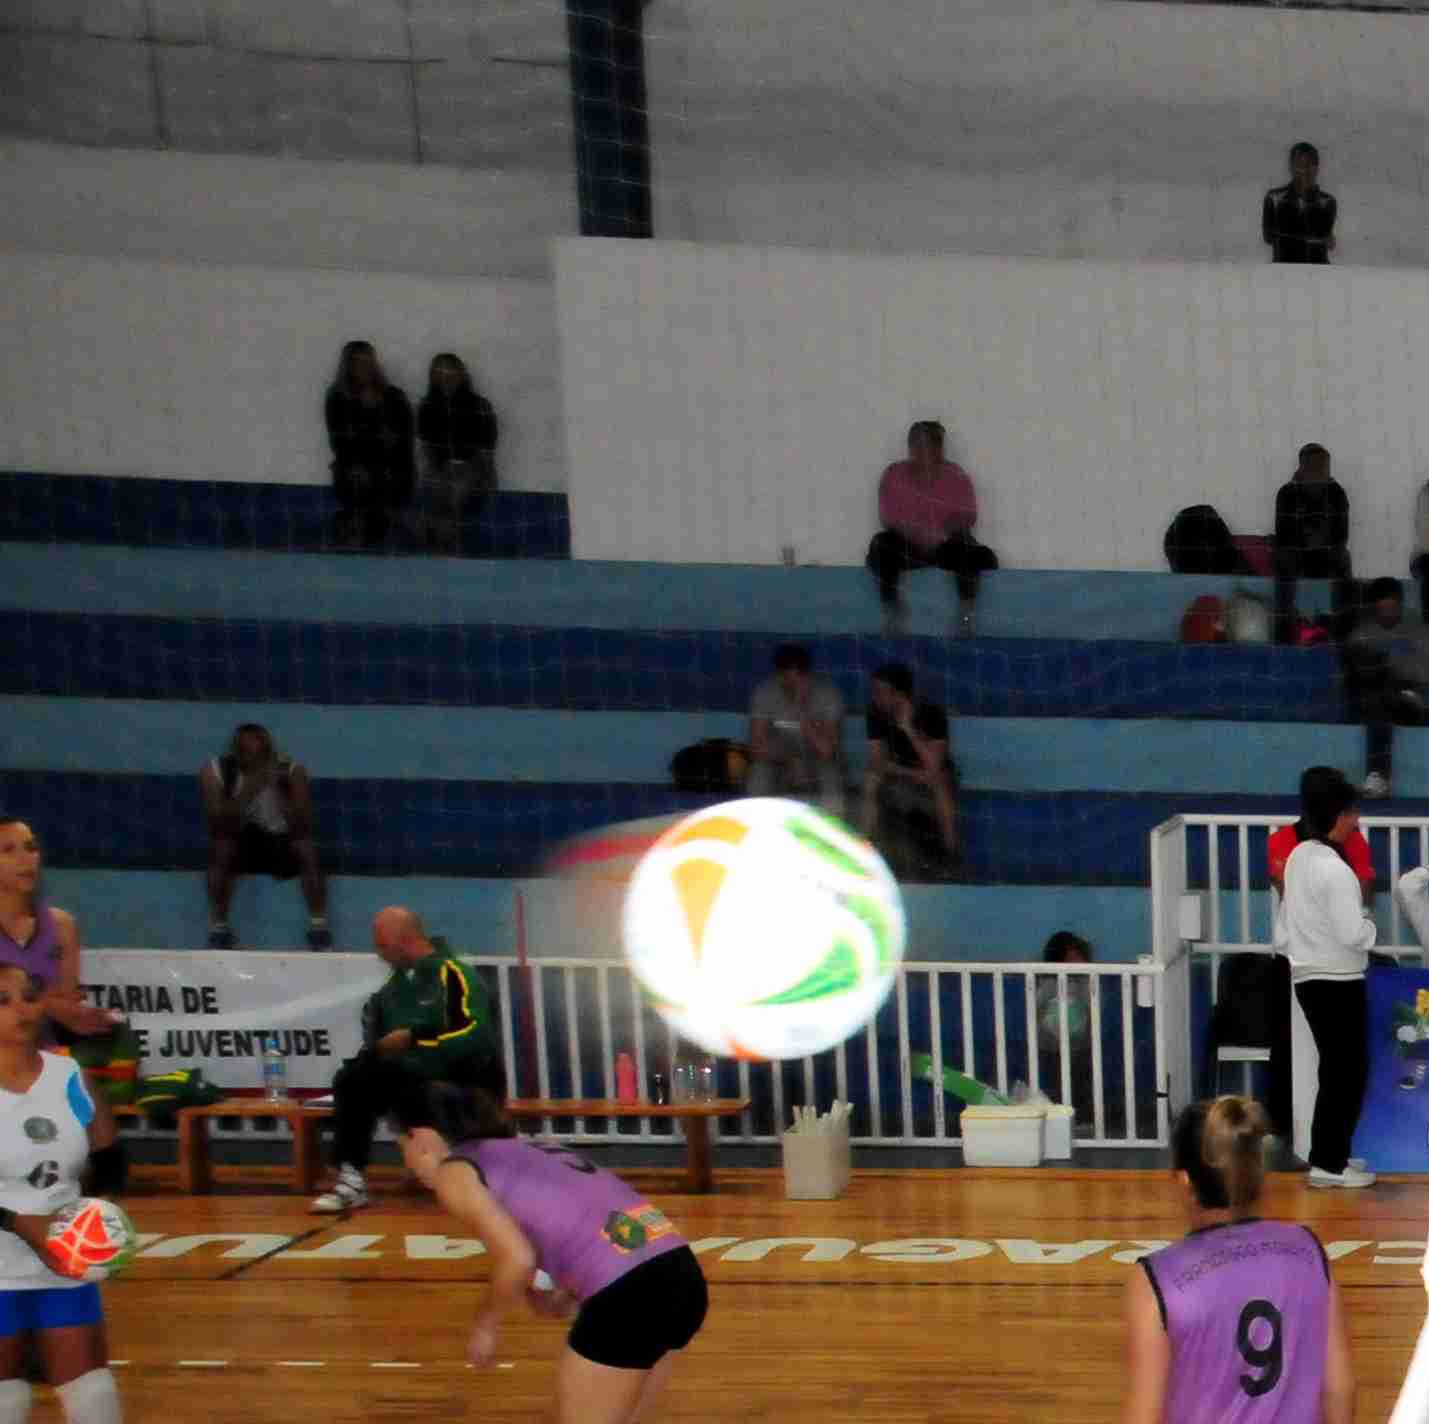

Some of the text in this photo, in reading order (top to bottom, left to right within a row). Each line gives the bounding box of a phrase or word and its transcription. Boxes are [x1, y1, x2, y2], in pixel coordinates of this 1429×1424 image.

[82, 984, 219, 1014] TARIA DE
[159, 1029, 332, 1057] JUVENTUDE
[26, 1159, 59, 1190] 6
[1237, 1299, 1284, 1397] 9
